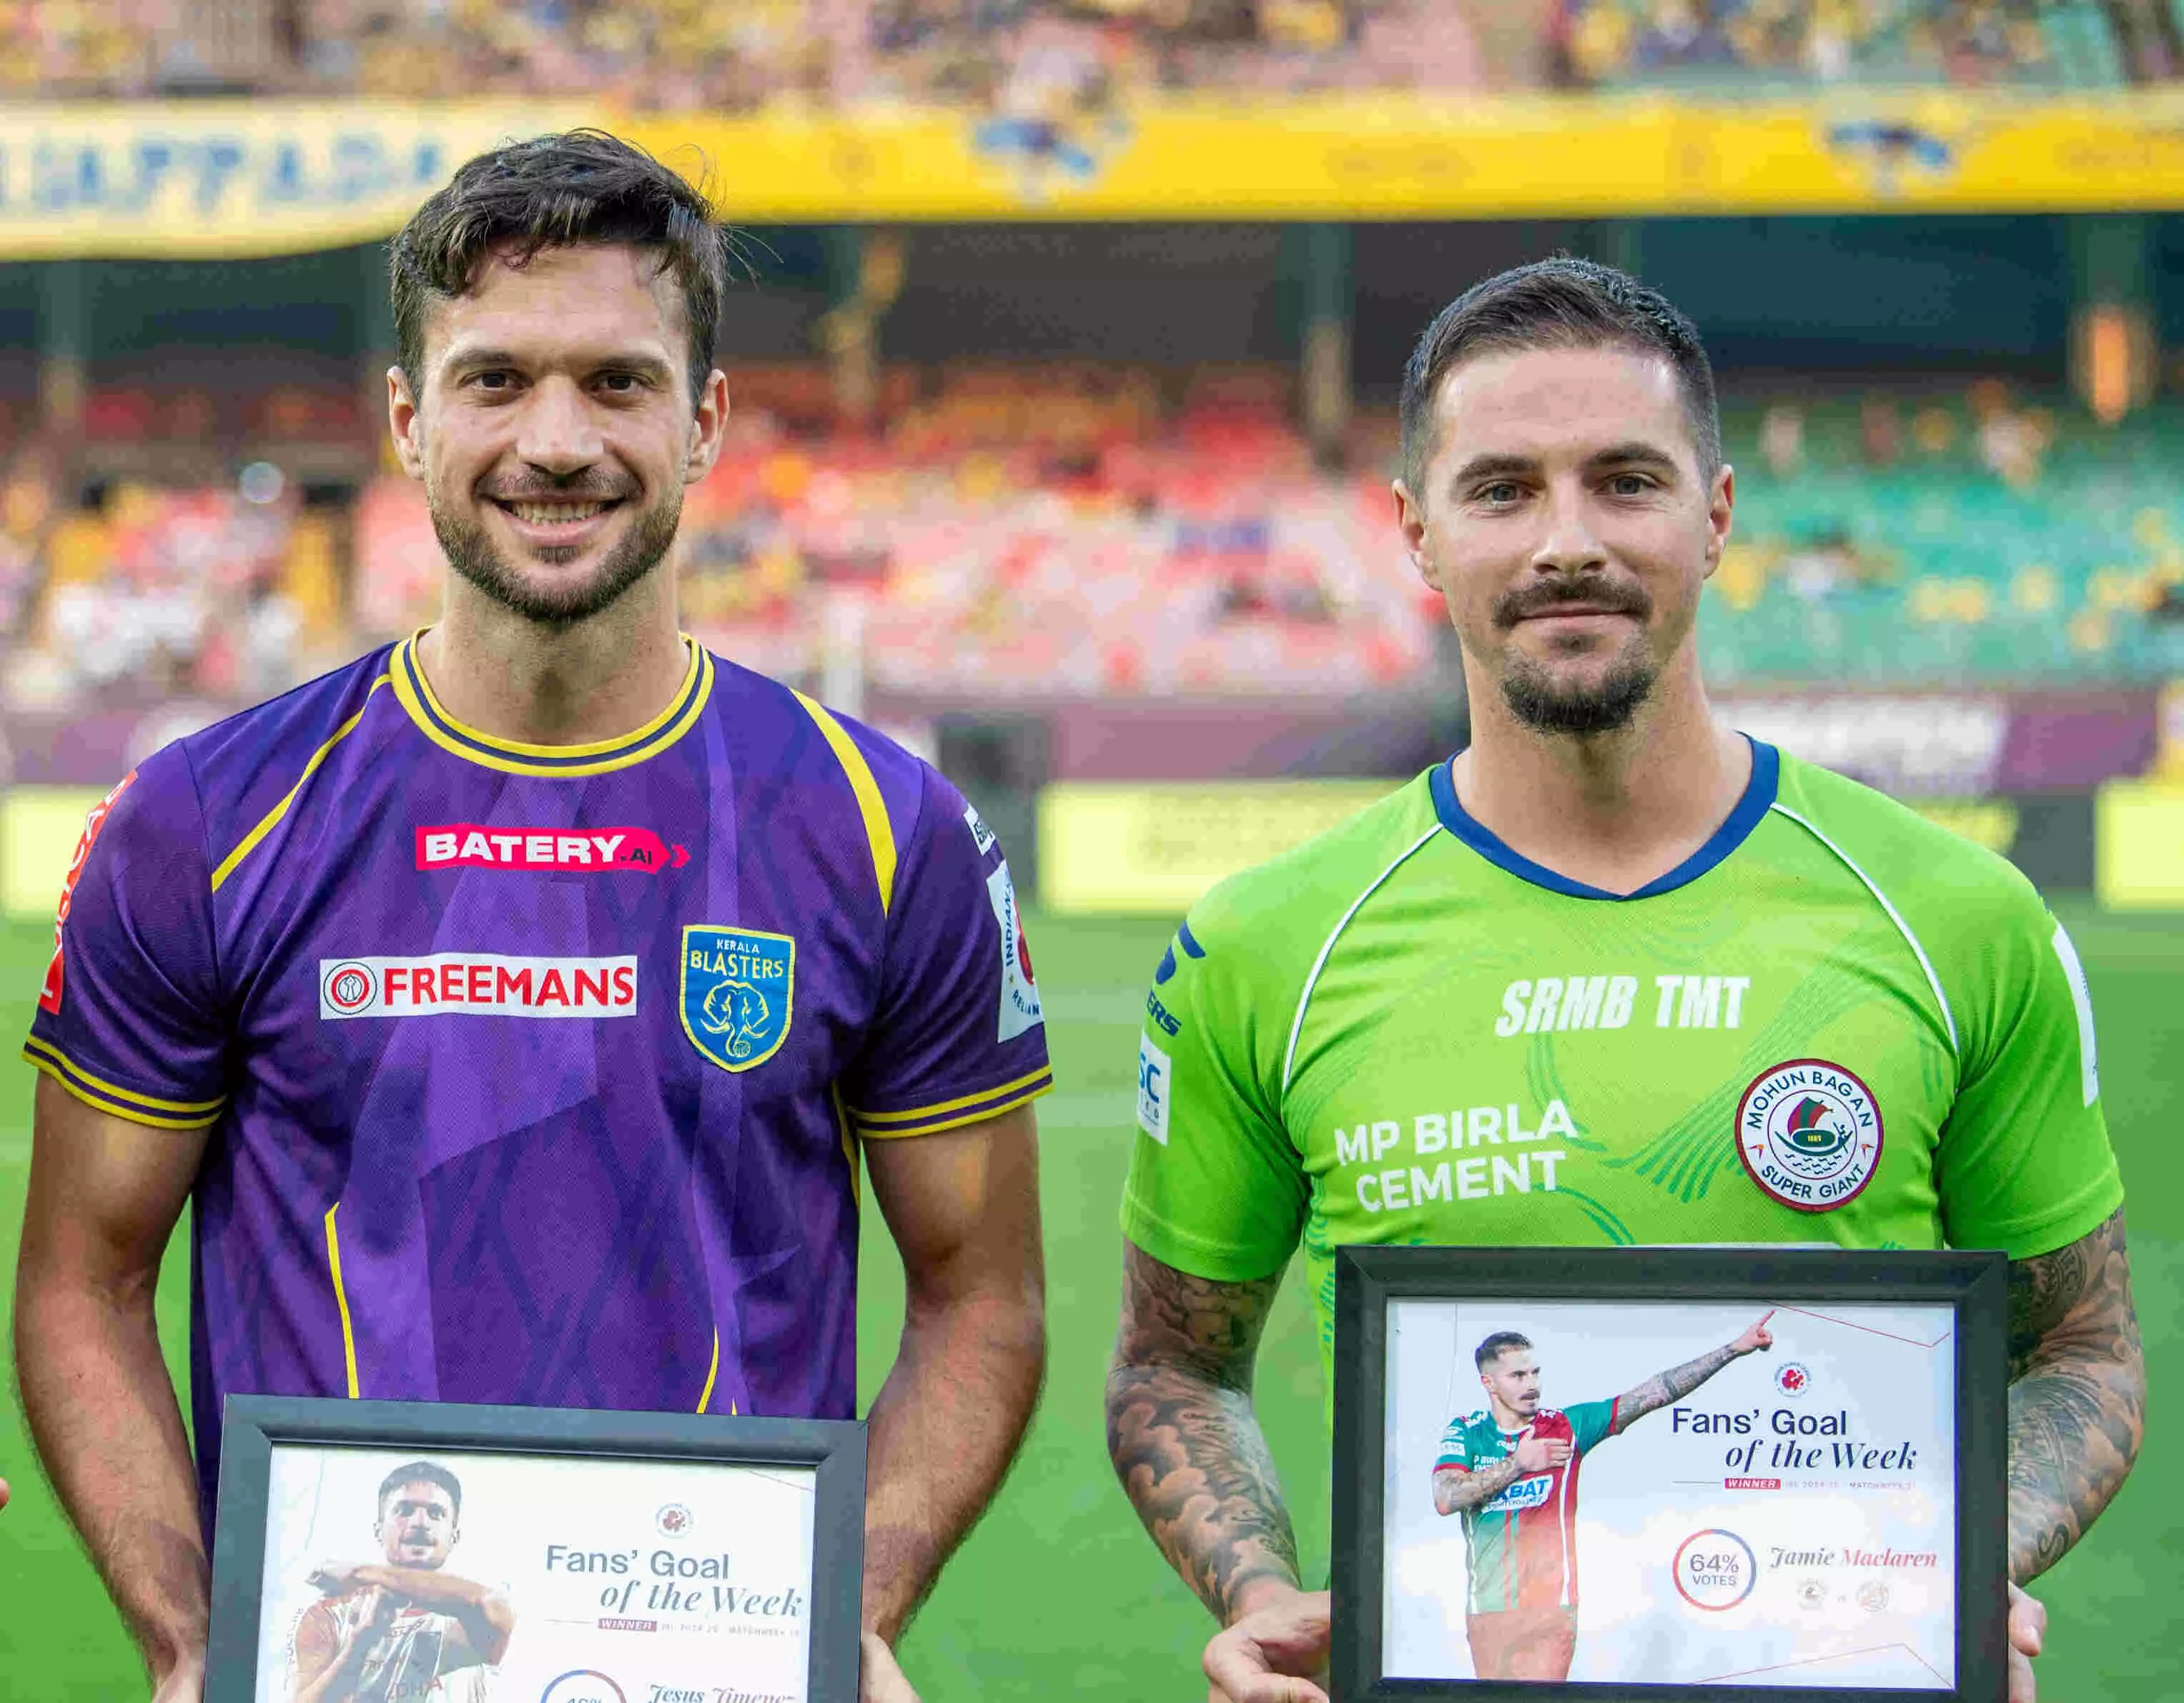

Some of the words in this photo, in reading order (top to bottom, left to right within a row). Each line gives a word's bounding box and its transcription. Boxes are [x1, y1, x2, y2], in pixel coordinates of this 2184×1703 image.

[716, 938, 761, 954] KERALA
[691, 949, 784, 979] BLASTERS
[384, 964, 634, 1007] FREEMANS
[1494, 975, 1639, 1037] SRMB
[1654, 974, 1751, 1029] TMT
[1746, 1070, 1807, 1130] MOHUN
[1812, 1071, 1873, 1127] BAGAN
[1333, 1120, 1400, 1166] MP
[1413, 1099, 1578, 1155] BIRLA
[1355, 1150, 1566, 1213] CEMENT
[1761, 1165, 1812, 1199] SUPER
[1819, 1163, 1864, 1198] GIANT
[1772, 1408, 1847, 1436] Goal
[1725, 1439, 1764, 1474] of
[1771, 1440, 1822, 1468] the
[1831, 1441, 1918, 1470] Week
[1727, 1479, 1777, 1489] WINNER
[650, 1549, 729, 1579] Goal
[1689, 1554, 1739, 1573] 64%
[1770, 1546, 1835, 1569] Jamie
[1842, 1548, 1937, 1568] Maclaren
[1692, 1574, 1737, 1586] VOTES
[600, 1579, 641, 1614] of
[647, 1581, 703, 1611] the
[713, 1585, 803, 1617] Week
[601, 1618, 653, 1632] WINNER
